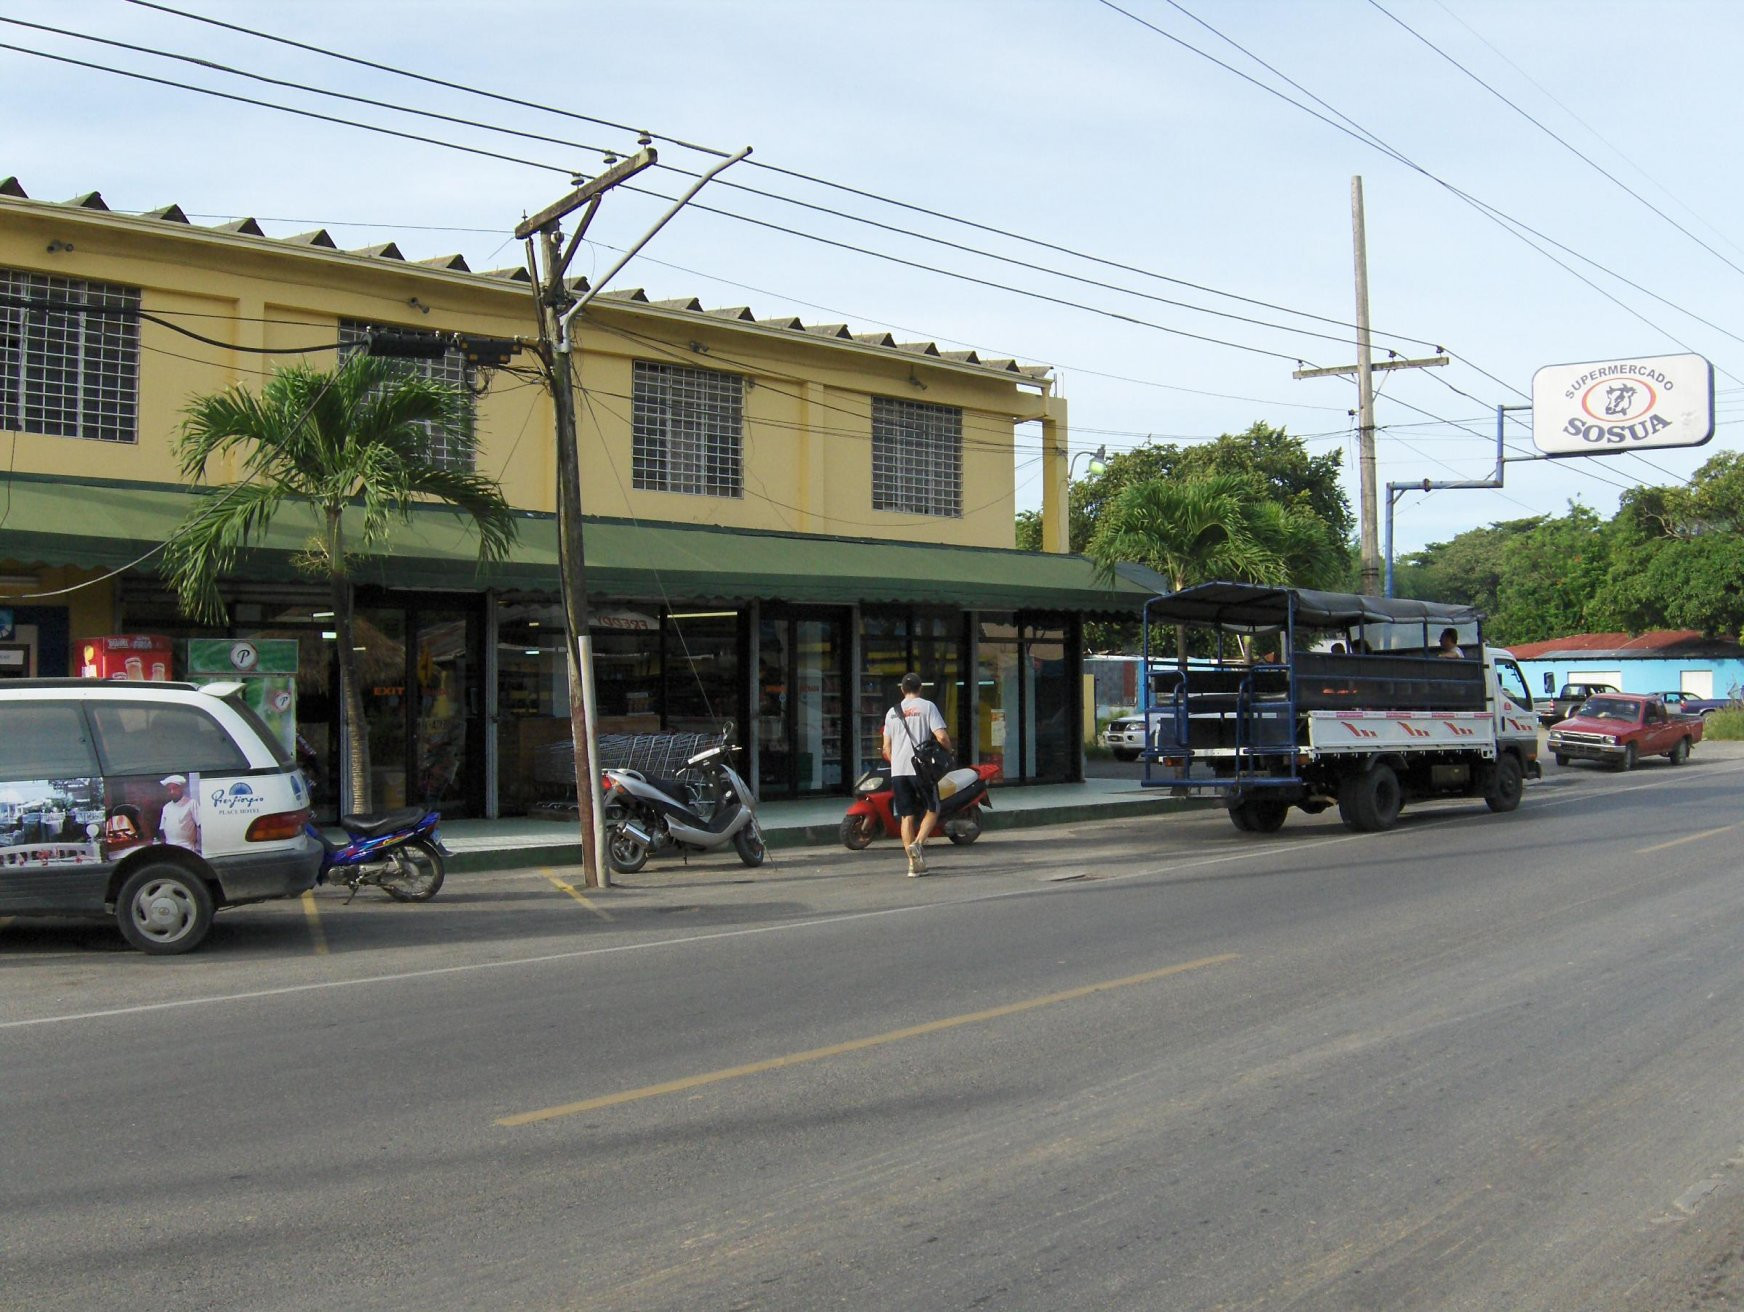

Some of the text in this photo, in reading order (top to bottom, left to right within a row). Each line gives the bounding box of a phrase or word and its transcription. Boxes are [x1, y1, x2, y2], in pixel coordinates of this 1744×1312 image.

[1565, 364, 1674, 399] SUPERMERCADO
[1563, 414, 1672, 444] SOSUA
[373, 687, 405, 696] EXIT
